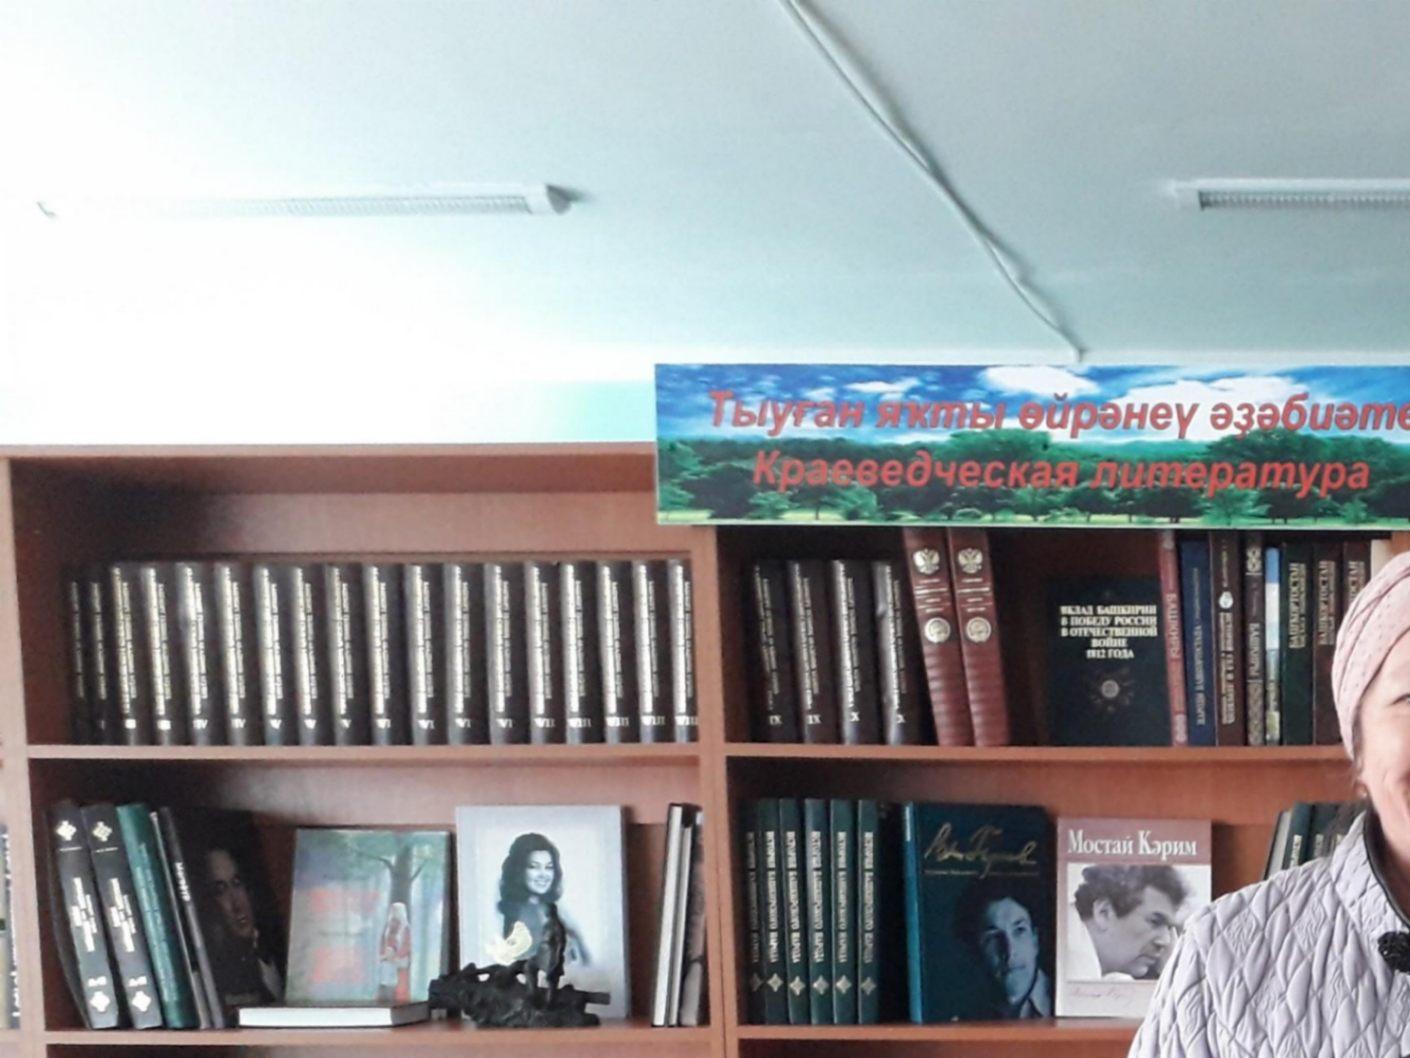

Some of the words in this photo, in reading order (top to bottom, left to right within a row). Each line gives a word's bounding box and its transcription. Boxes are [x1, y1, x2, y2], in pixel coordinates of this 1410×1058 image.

[708, 389, 866, 437] Тыуған
[1018, 392, 1200, 439] өйрәнеү
[752, 449, 1081, 492] Краеведческая
[1089, 459, 1371, 499] литература
[1059, 604, 1094, 615] ВКЛАД
[1060, 616, 1069, 626] В
[1070, 616, 1112, 626] ПОБЕДУ
[1114, 616, 1158, 626] РОССИИ
[1060, 627, 1069, 637] В
[1091, 637, 1128, 648] ВОЙНЕ
[1107, 649, 1135, 659] ГОДА
[1067, 829, 1133, 856] Мостай
[1137, 829, 1197, 861] Кәрим
